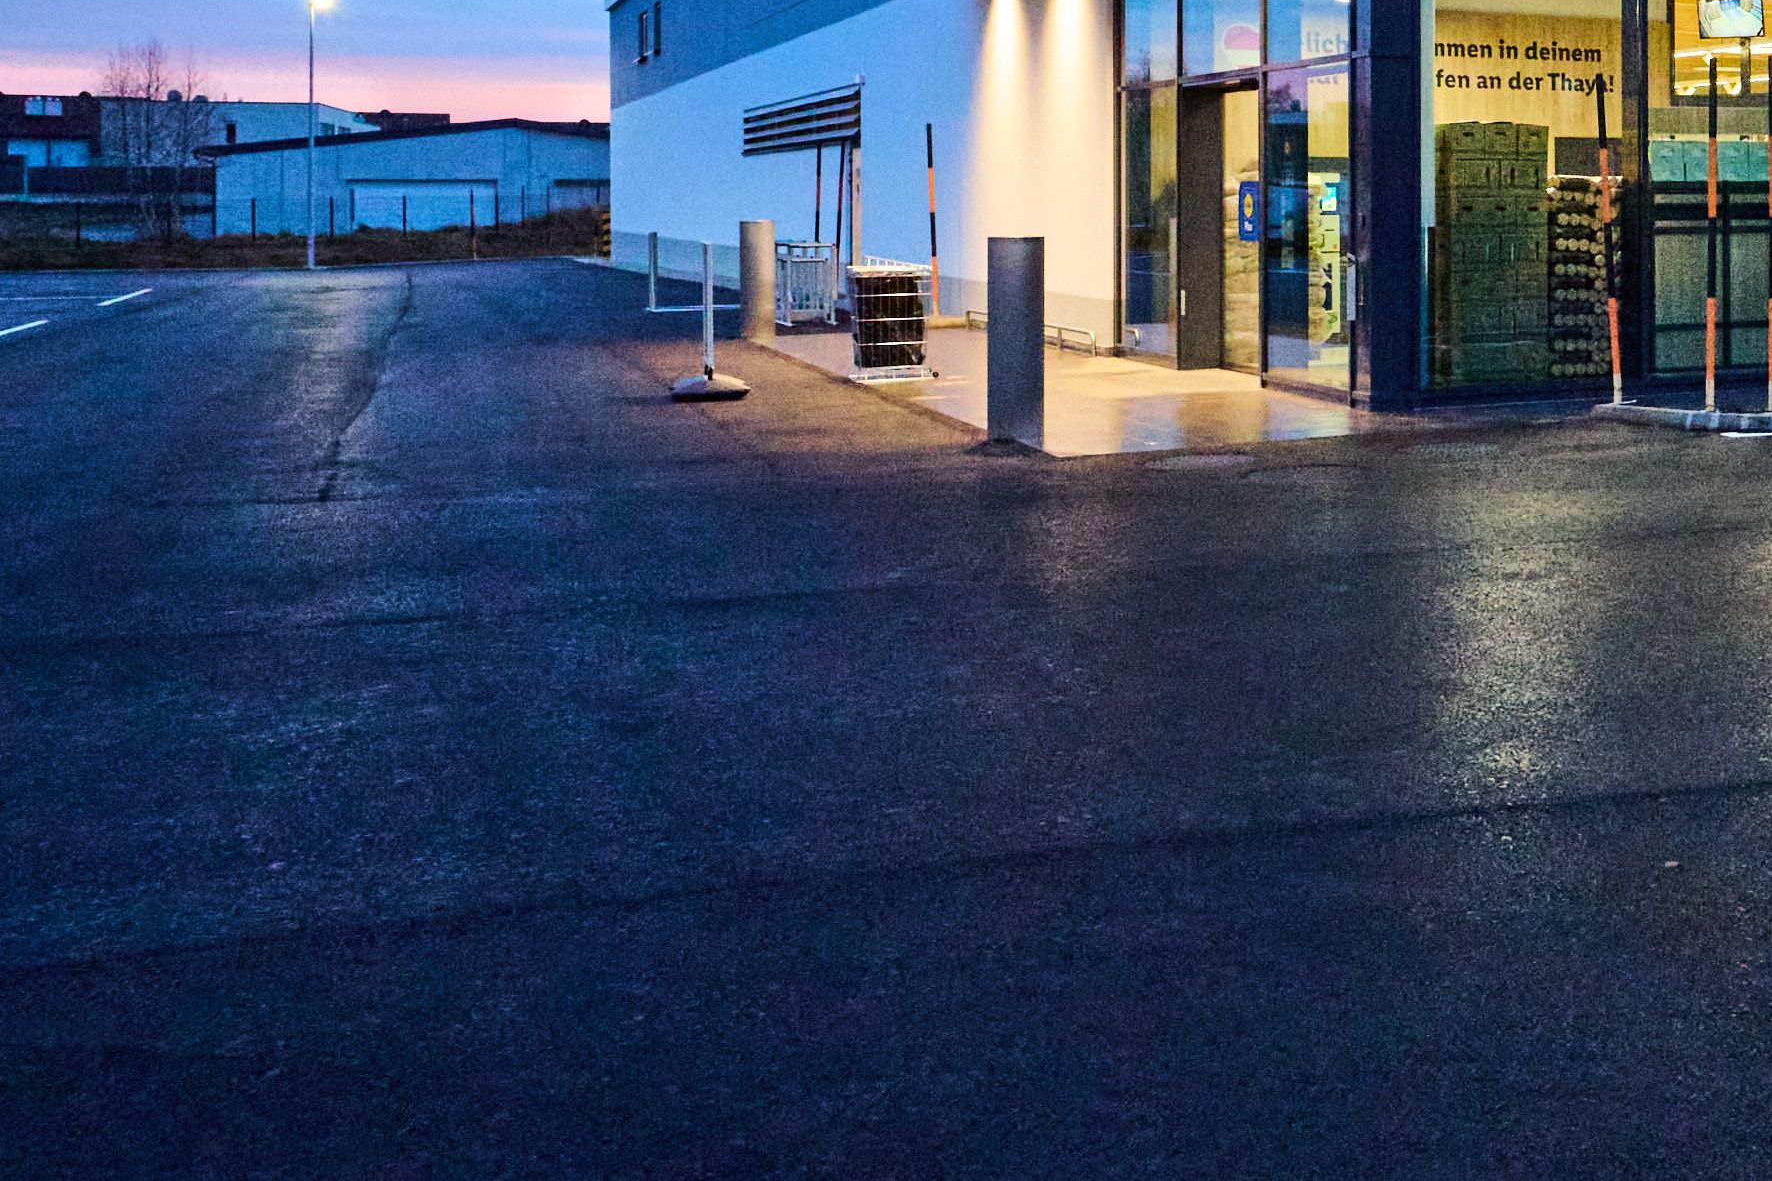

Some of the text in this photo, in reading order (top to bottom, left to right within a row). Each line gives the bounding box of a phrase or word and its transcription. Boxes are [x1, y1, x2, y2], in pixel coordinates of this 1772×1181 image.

[1499, 39, 1518, 60] in
[1524, 41, 1601, 63] deinem
[1477, 74, 1501, 89] an
[1508, 71, 1543, 91] der
